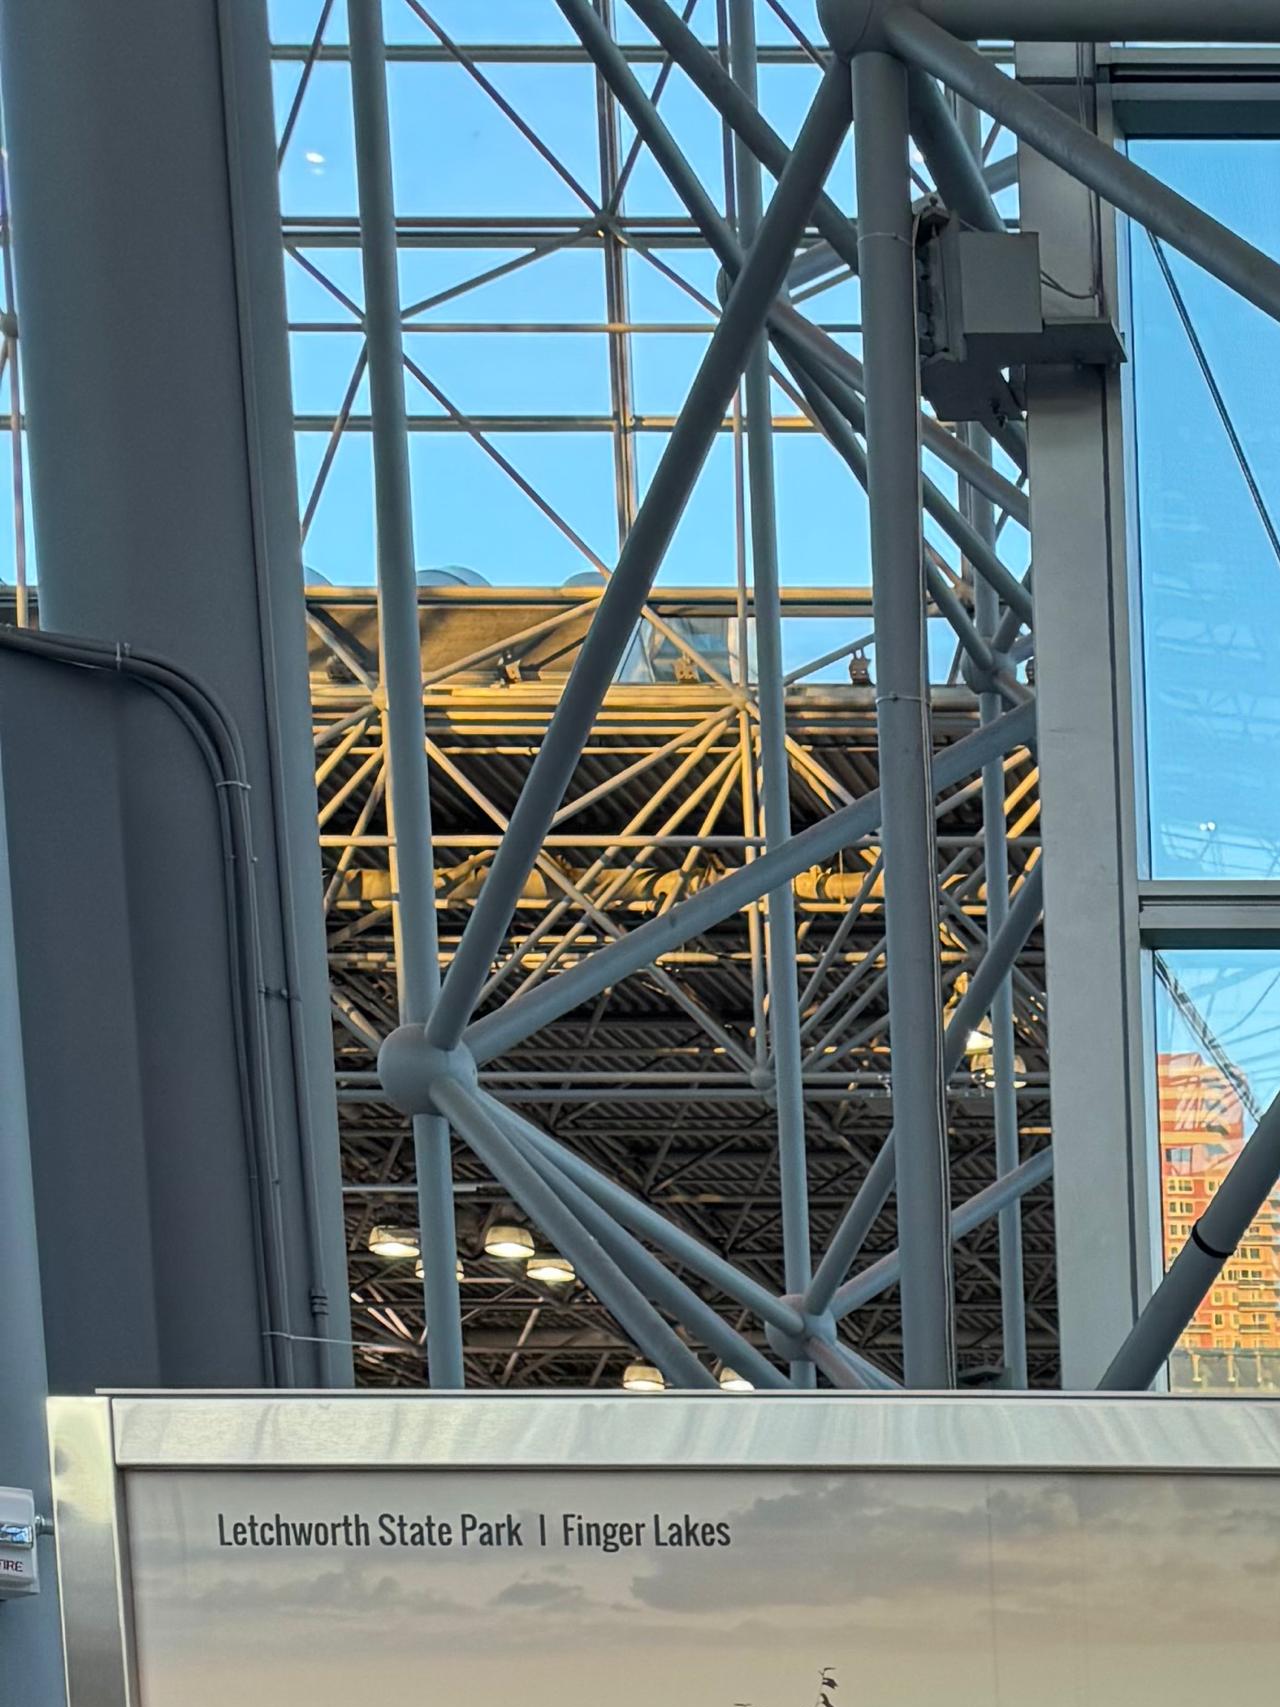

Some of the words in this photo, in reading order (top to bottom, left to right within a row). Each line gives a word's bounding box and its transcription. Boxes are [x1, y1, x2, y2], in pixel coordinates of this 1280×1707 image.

[217, 1513, 371, 1547] Letchworth
[378, 1513, 453, 1547] State
[460, 1513, 524, 1547] Park
[562, 1513, 646, 1553] Finger
[653, 1513, 732, 1547] Lakes
